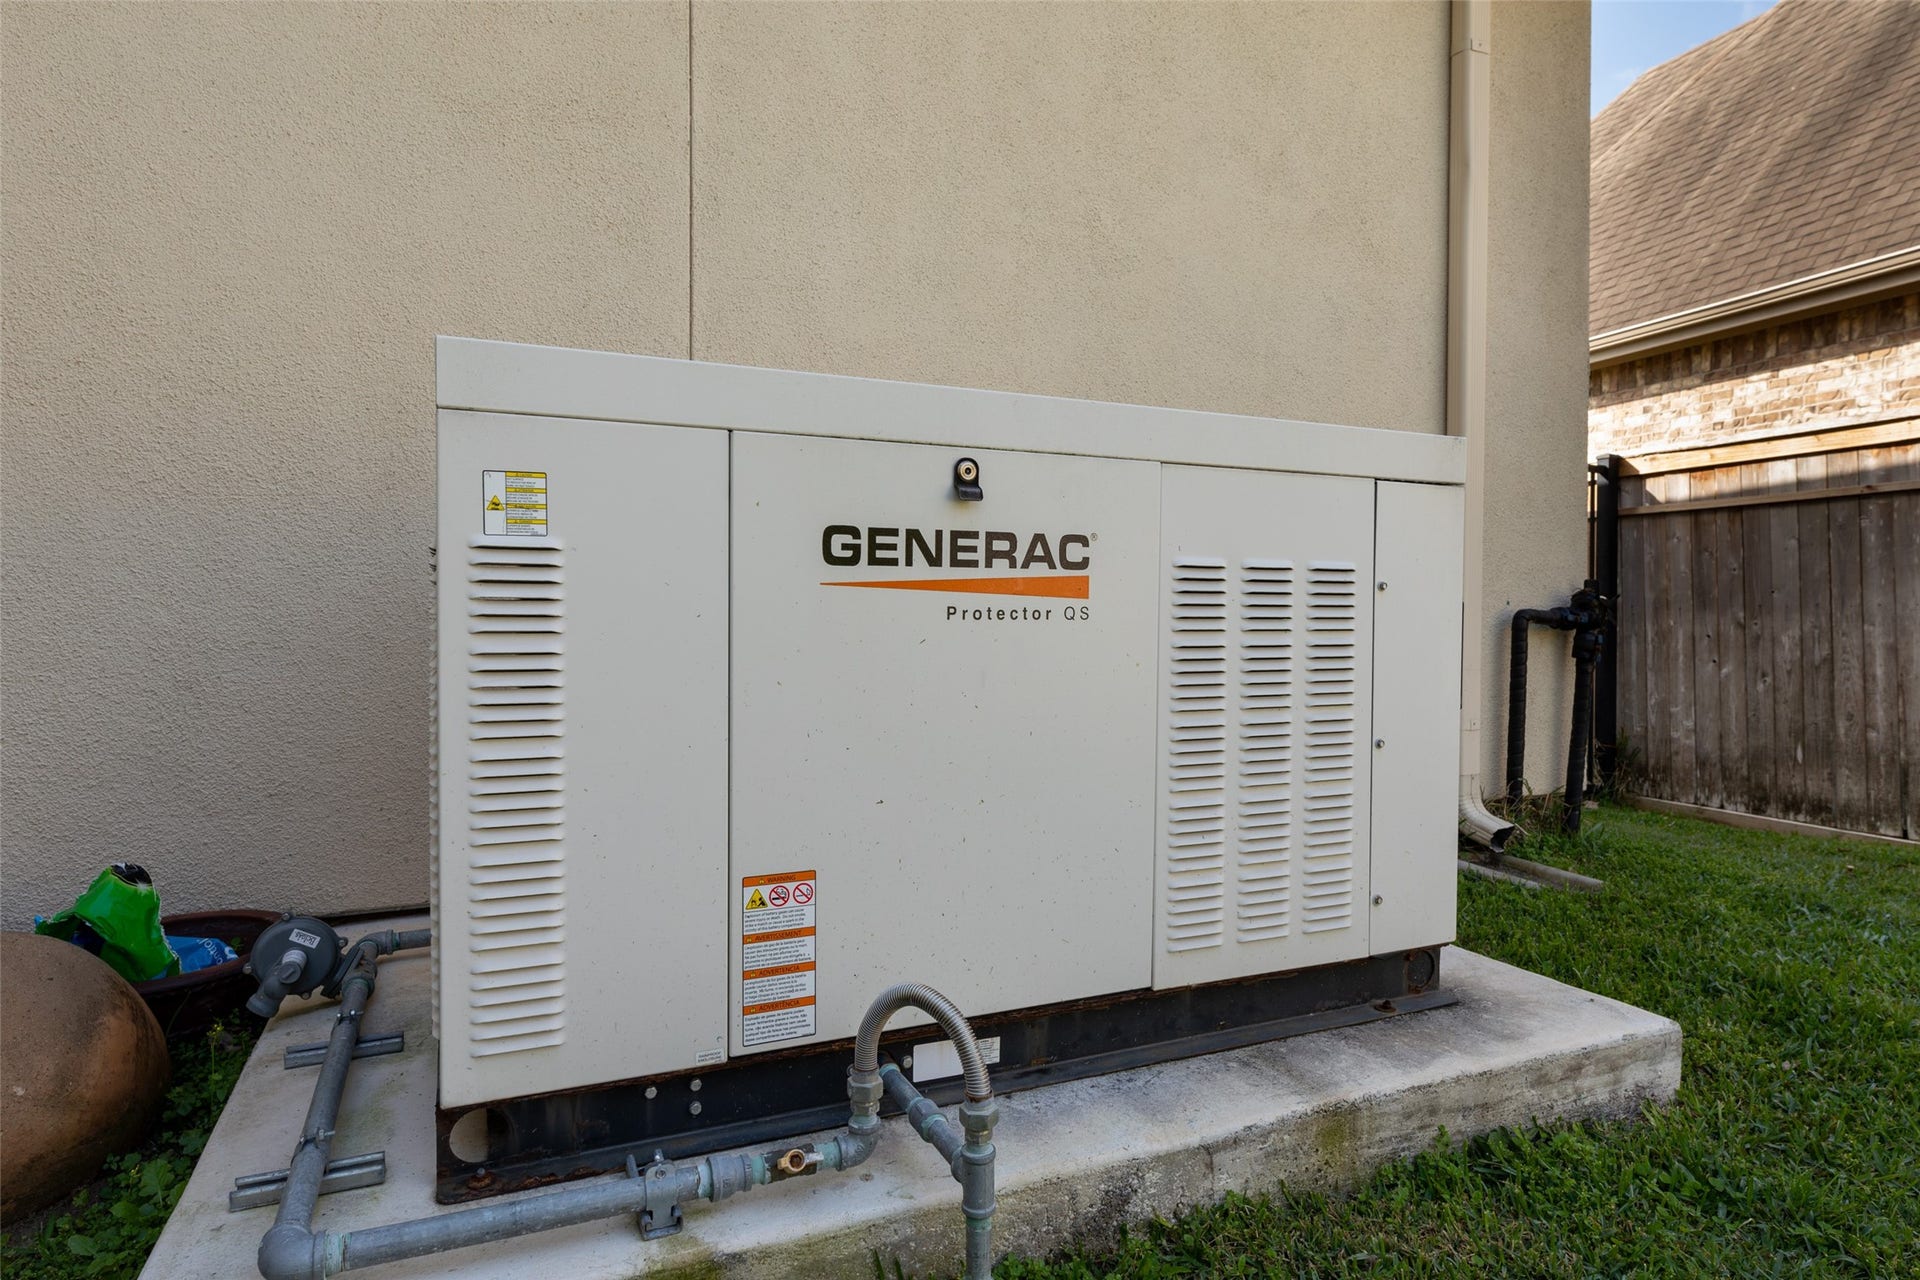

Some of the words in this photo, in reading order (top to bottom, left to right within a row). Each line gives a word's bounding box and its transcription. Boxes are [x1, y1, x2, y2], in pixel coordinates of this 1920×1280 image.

[946, 606, 1052, 620] Protector
[1064, 606, 1090, 620] QS
[768, 874, 796, 883] WARNING
